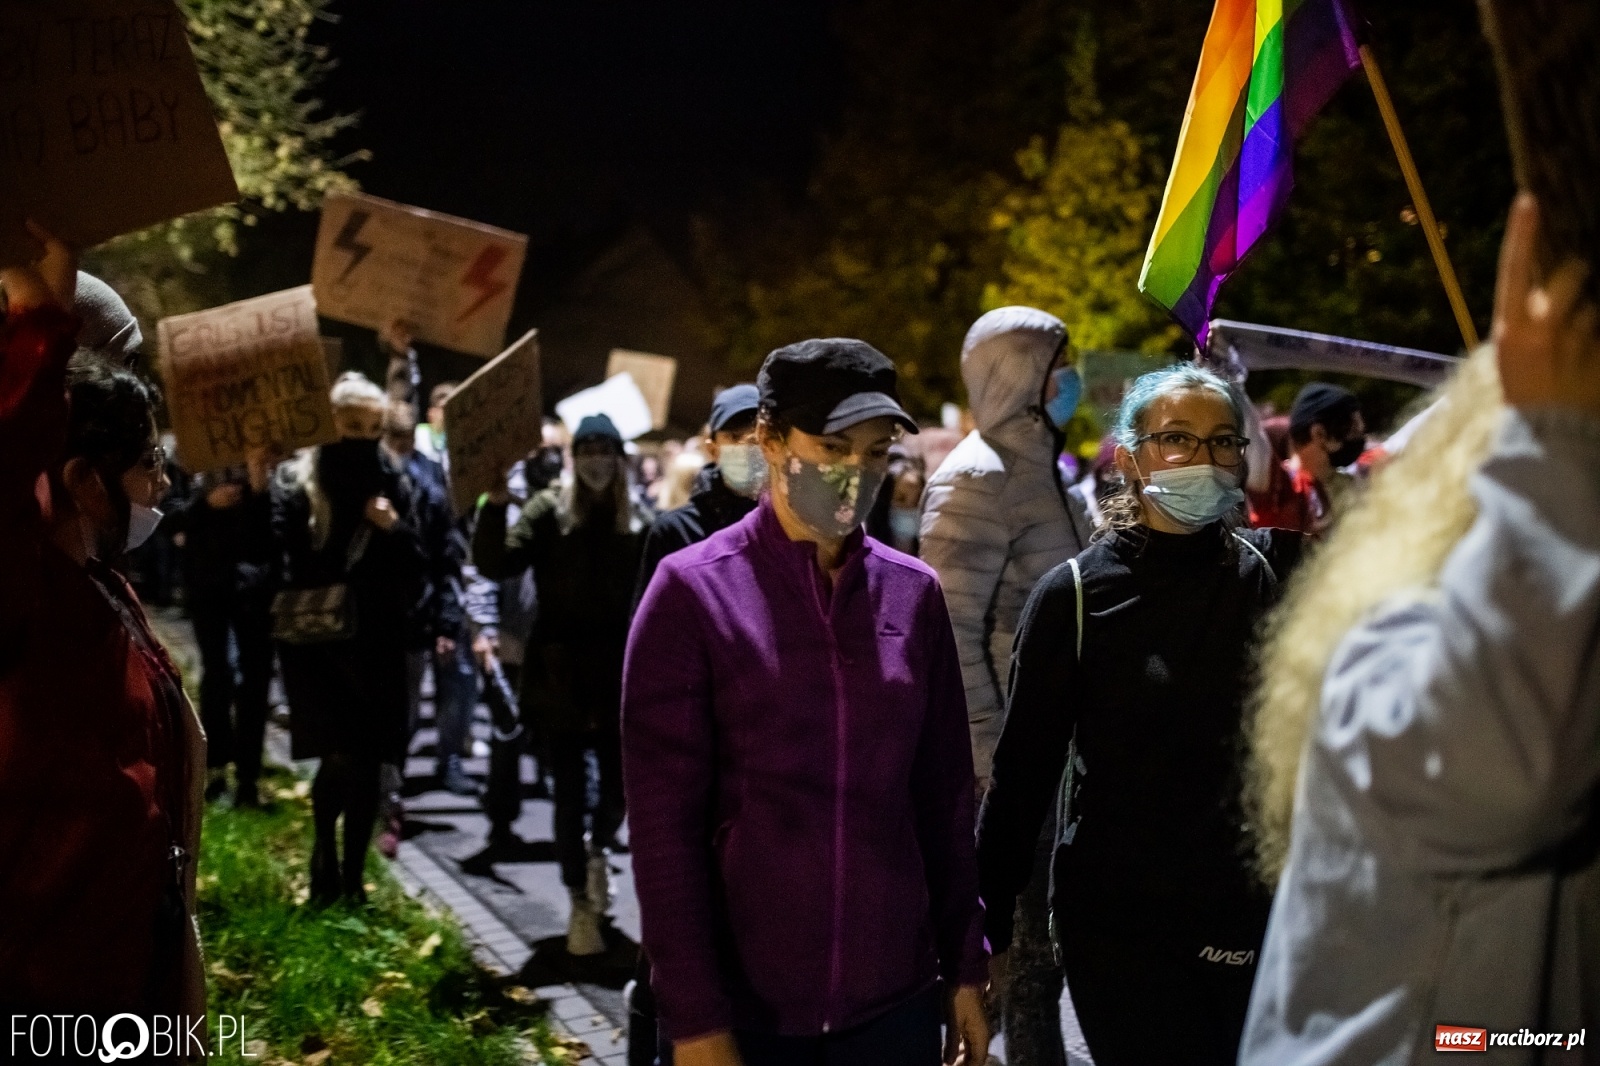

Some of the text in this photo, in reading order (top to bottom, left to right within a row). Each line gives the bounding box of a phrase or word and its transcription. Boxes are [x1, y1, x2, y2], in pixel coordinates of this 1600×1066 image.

[56, 11, 181, 76] TERAZ
[65, 88, 179, 155] BABY
[1198, 945, 1256, 966] NASA
